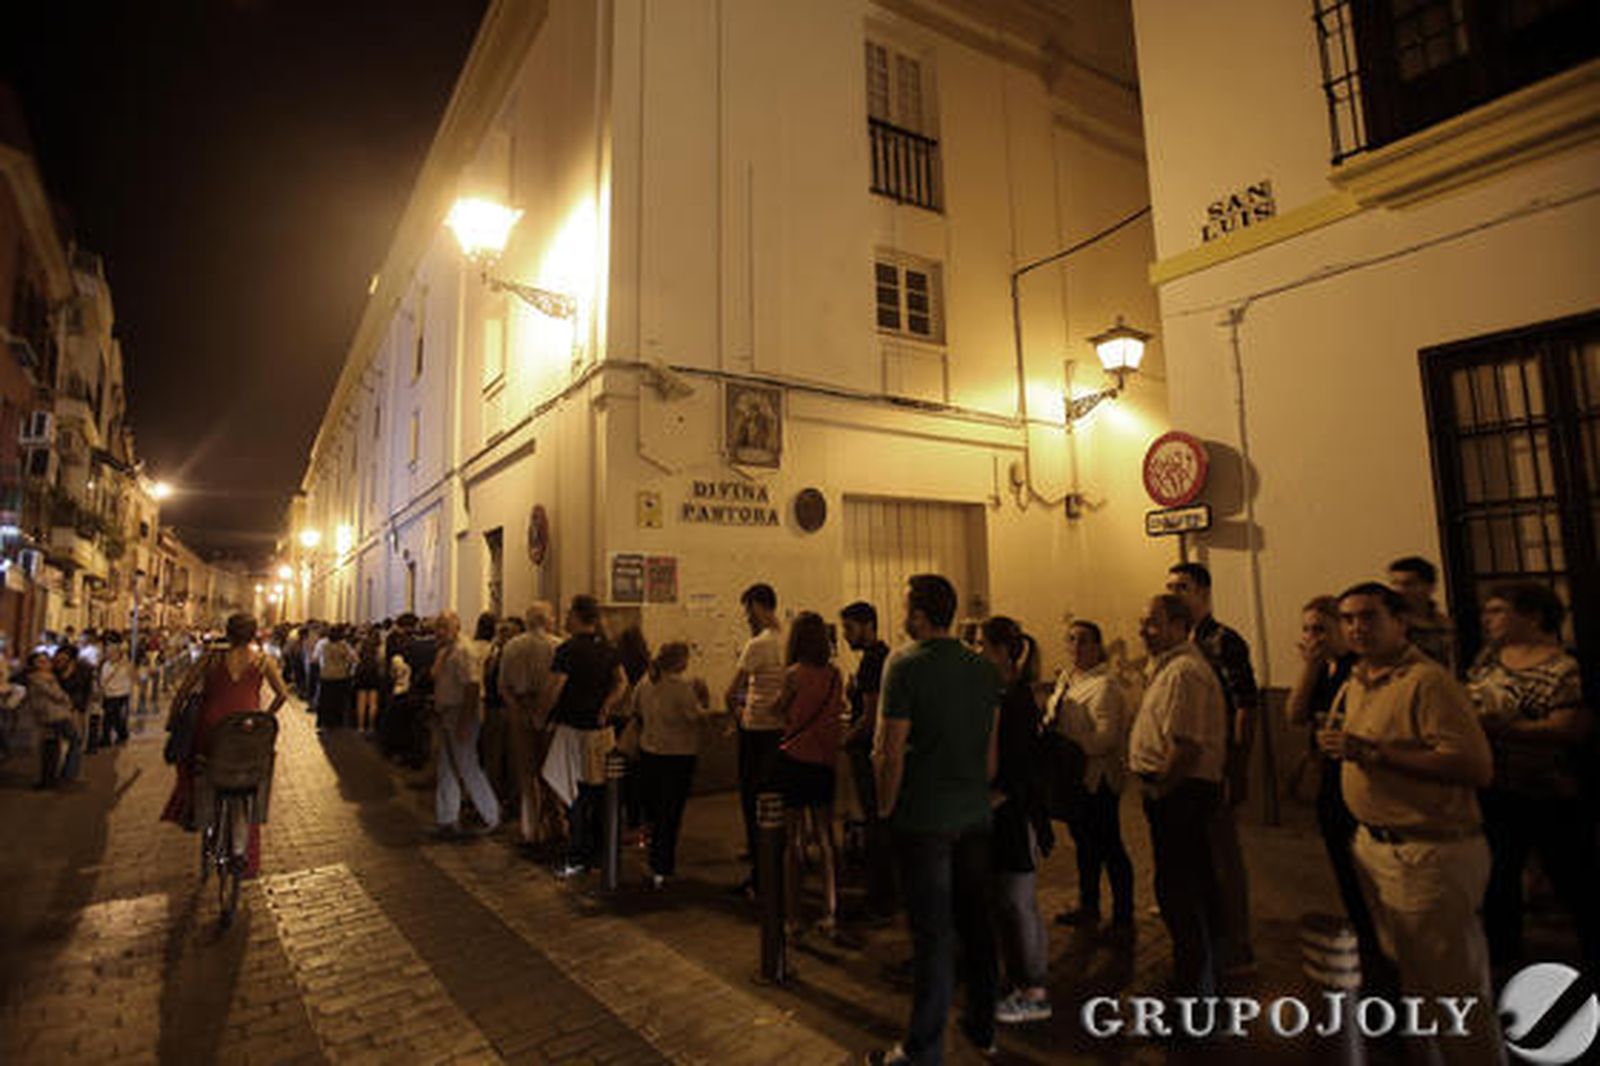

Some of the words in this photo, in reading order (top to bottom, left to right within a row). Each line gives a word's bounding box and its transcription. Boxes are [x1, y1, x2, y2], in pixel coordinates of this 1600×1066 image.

[1207, 180, 1272, 220] SAN
[1201, 201, 1275, 242] LUIS
[693, 480, 768, 502] DIVINA
